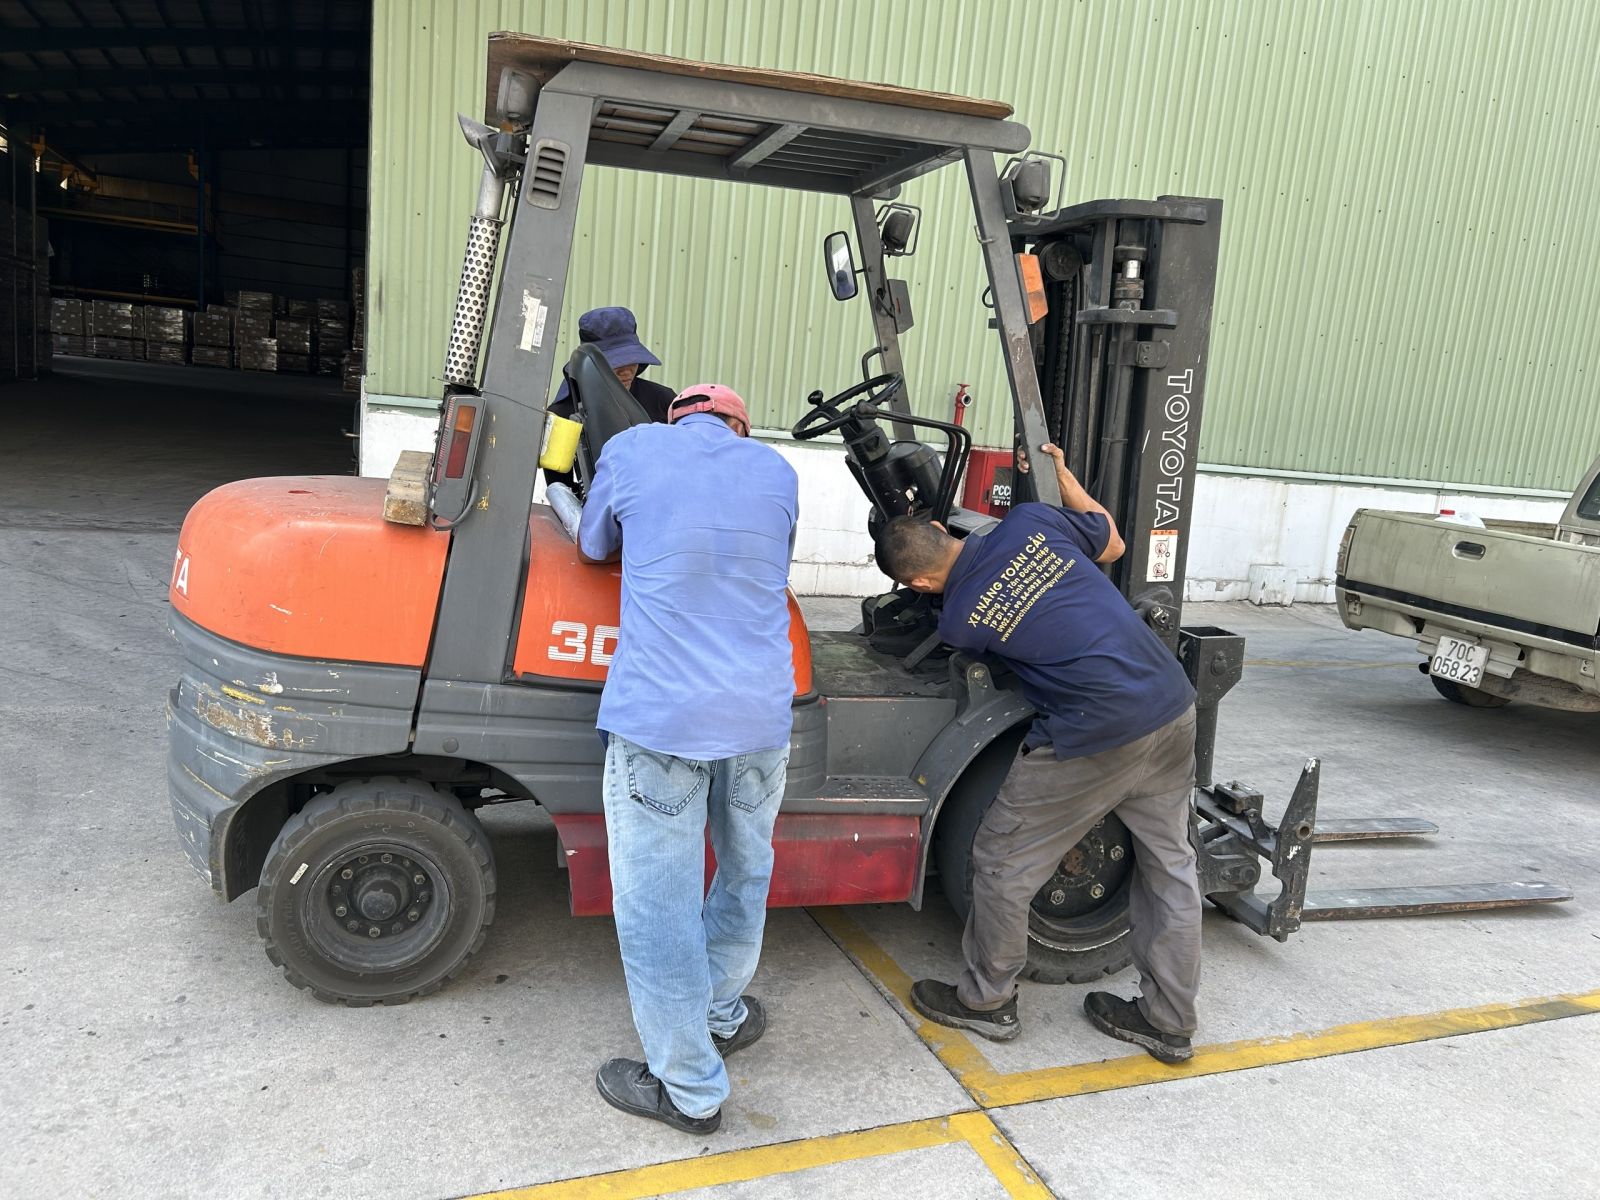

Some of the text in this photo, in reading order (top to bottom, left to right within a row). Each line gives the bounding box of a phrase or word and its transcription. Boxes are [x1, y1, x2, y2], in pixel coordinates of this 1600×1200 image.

[1154, 369, 1193, 528] TOYOTA
[967, 612, 981, 628] XE
[1001, 552, 1028, 581] TOÀN
[998, 593, 1007, 602] 11
[990, 620, 998, 629] TP
[1002, 602, 1011, 613] An
[1448, 640, 1476, 662] 70C
[1433, 656, 1480, 684] 058.23
